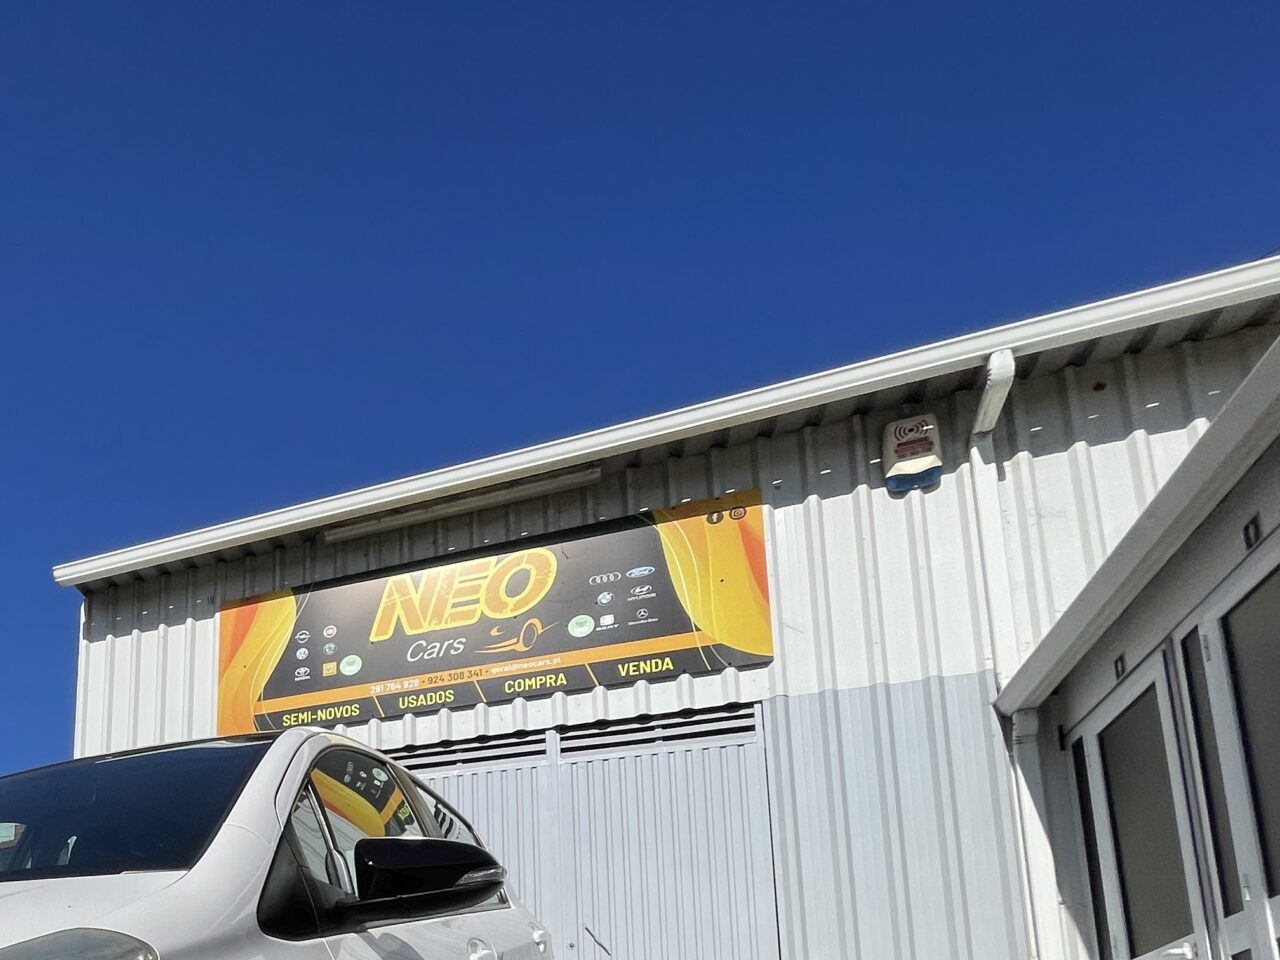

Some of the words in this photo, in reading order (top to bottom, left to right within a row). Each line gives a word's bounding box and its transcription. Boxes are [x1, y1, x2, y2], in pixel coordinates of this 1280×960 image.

[370, 547, 558, 642] NEO
[406, 637, 467, 662] Cars
[618, 656, 674, 677] VENDA
[370, 683, 385, 695] 291
[386, 681, 403, 692] 764
[427, 674, 445, 685] 924
[447, 671, 465, 682] 308
[467, 669, 484, 680] 341
[504, 673, 568, 694] COMPRA
[399, 689, 455, 709] USADOS
[282, 703, 360, 727] SEMI-NOVOS
